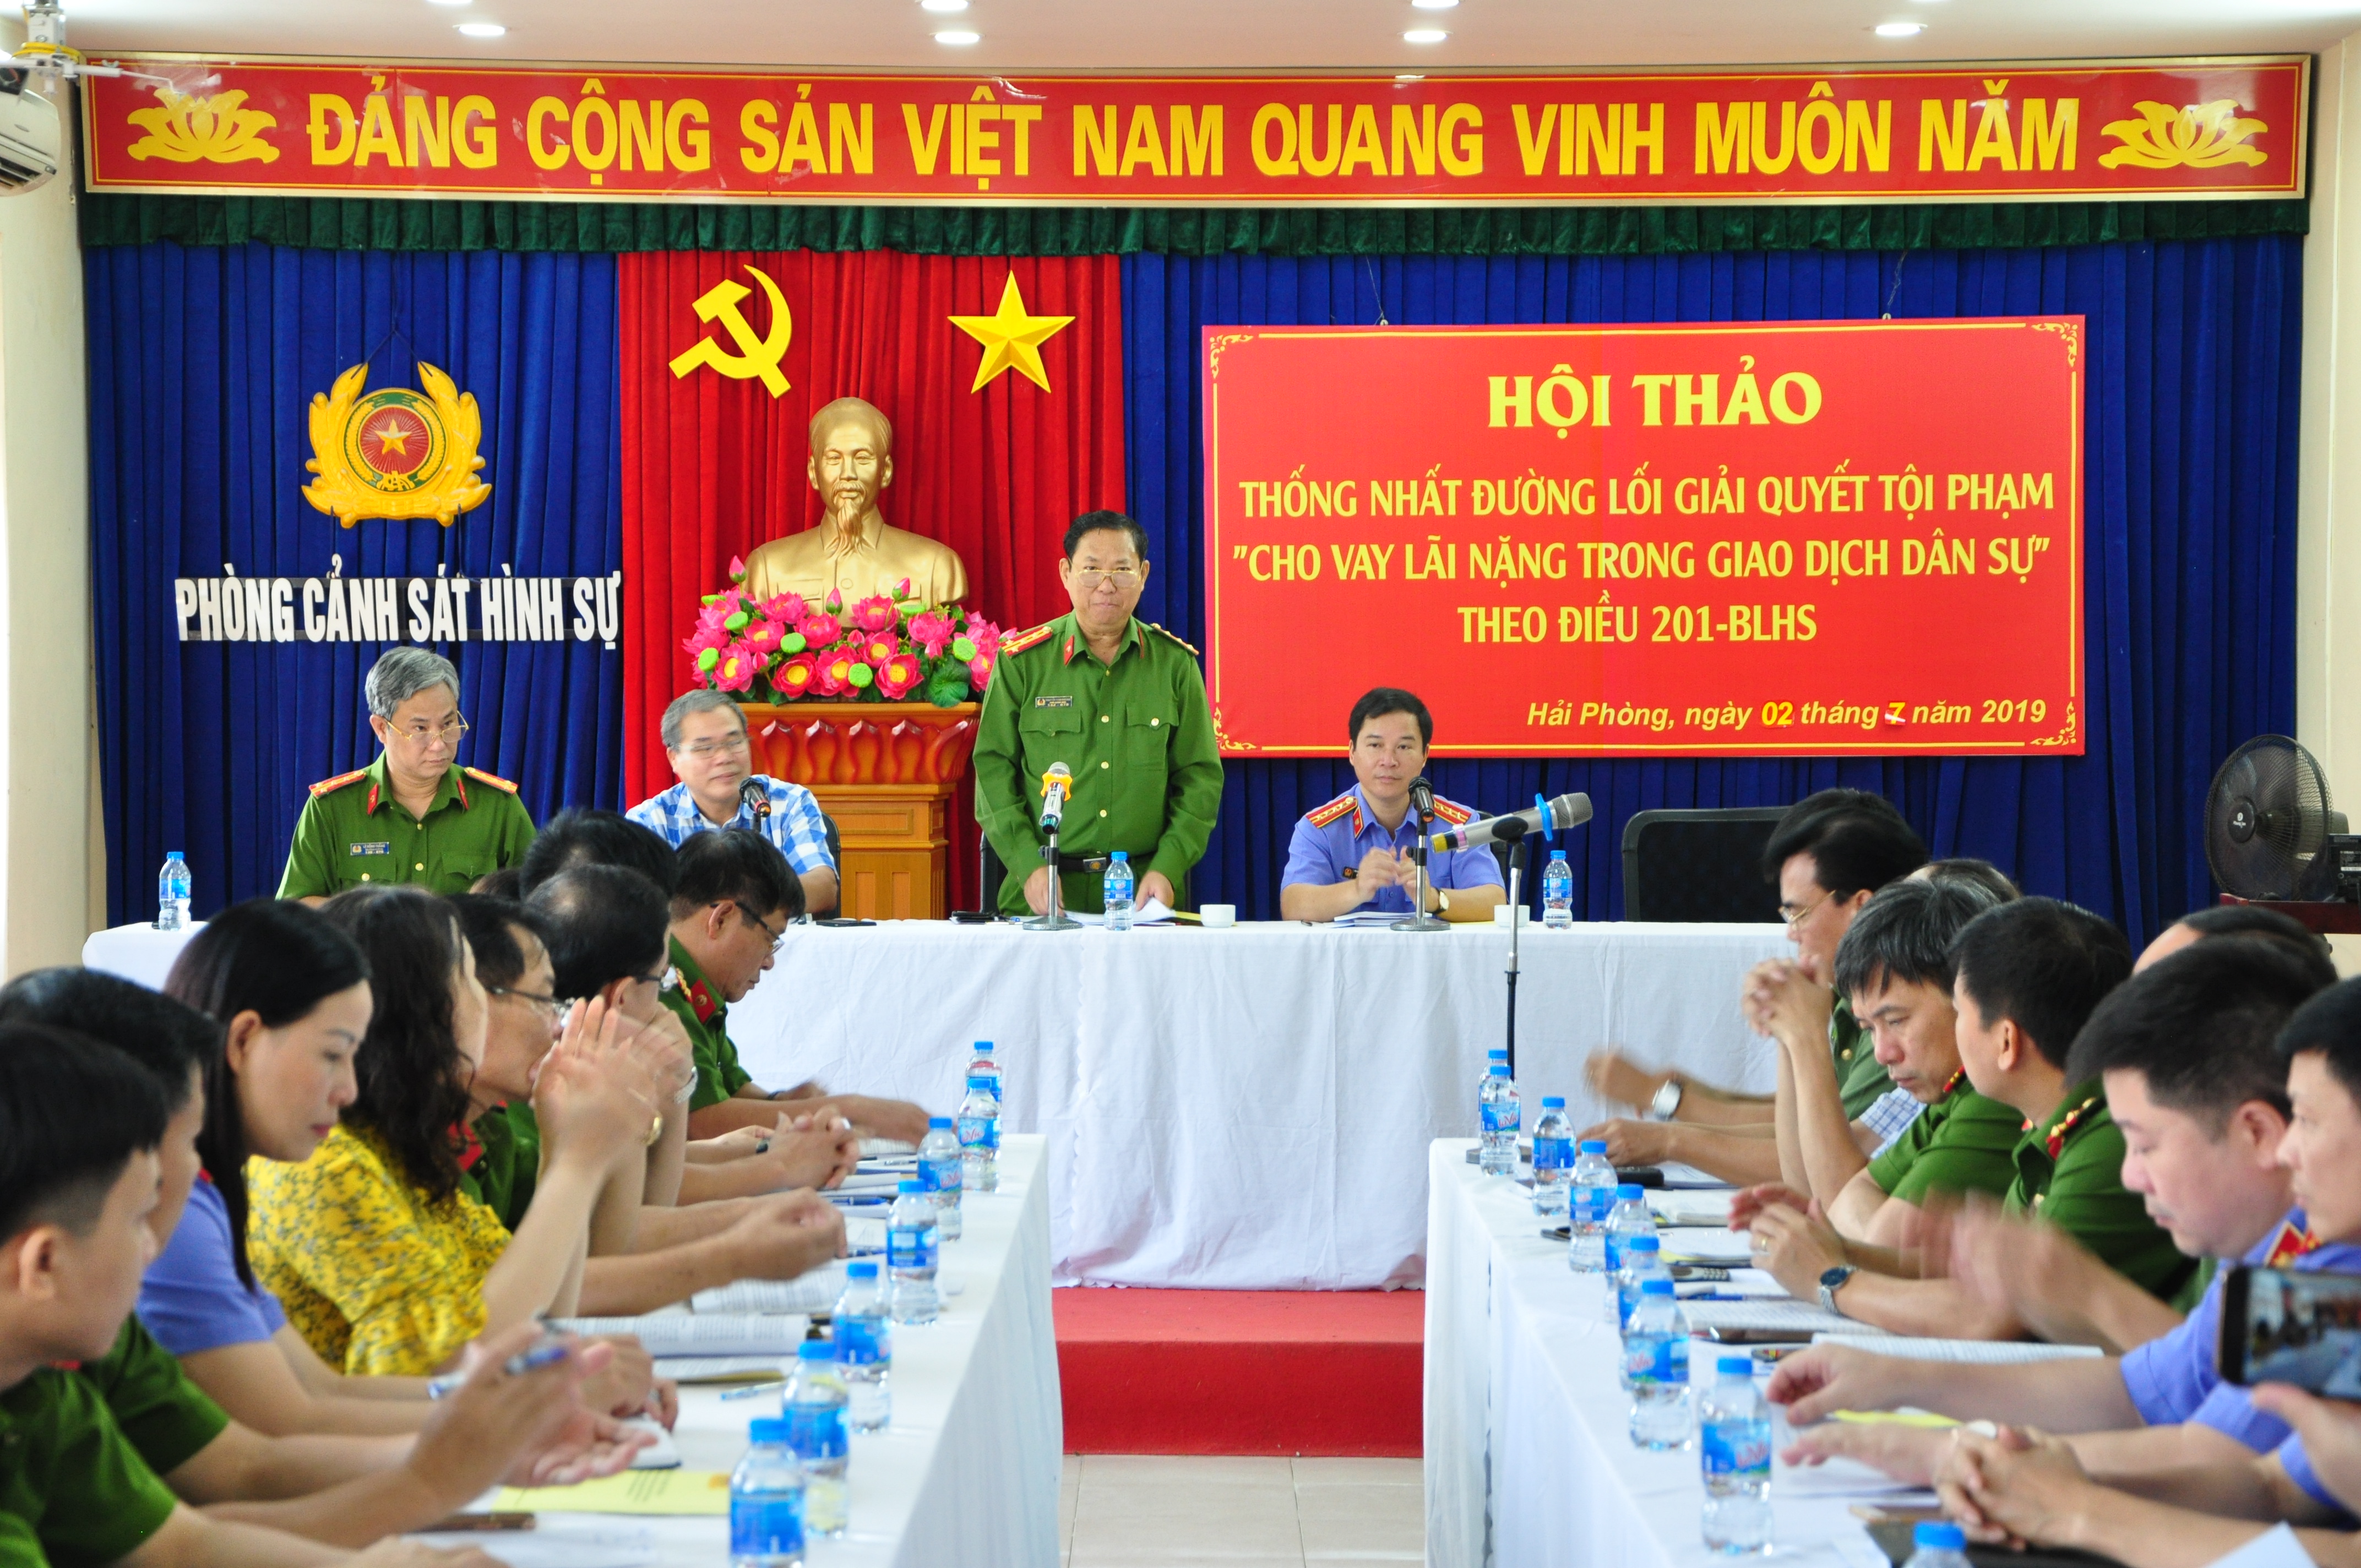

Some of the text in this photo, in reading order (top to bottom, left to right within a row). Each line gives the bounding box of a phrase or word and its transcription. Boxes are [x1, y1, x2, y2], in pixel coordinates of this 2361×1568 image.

[307, 75, 2080, 189] ĐẢNG CỘNG SẢN VIỆT NAM QUANG VINH MUÔN NĂM
[1488, 355, 1822, 439] HỘI THẢO
[1239, 459, 2053, 520] THỐNG NHẤT ĐƯỜNG LỐI GIẢI QUYẾT TỘI PHẠM
[1330, 544, 1395, 580] VAY
[1405, 535, 1456, 580] LÃI
[1470, 536, 1566, 589] NẶNG
[1577, 542, 1694, 579] TRONG
[1708, 541, 1793, 578] GIAO
[1806, 540, 1888, 585] DỊCH
[1902, 527, 1975, 576] DÂN
[175, 554, 622, 650] PHÒNG CẢNH SÁT HÌNH SỰ
[1457, 590, 1817, 643] THEO ĐIỀU 201-BLHS
[1527, 699, 2047, 732] Hải Phòng, ngày 02 tháng 7 năm 2019
